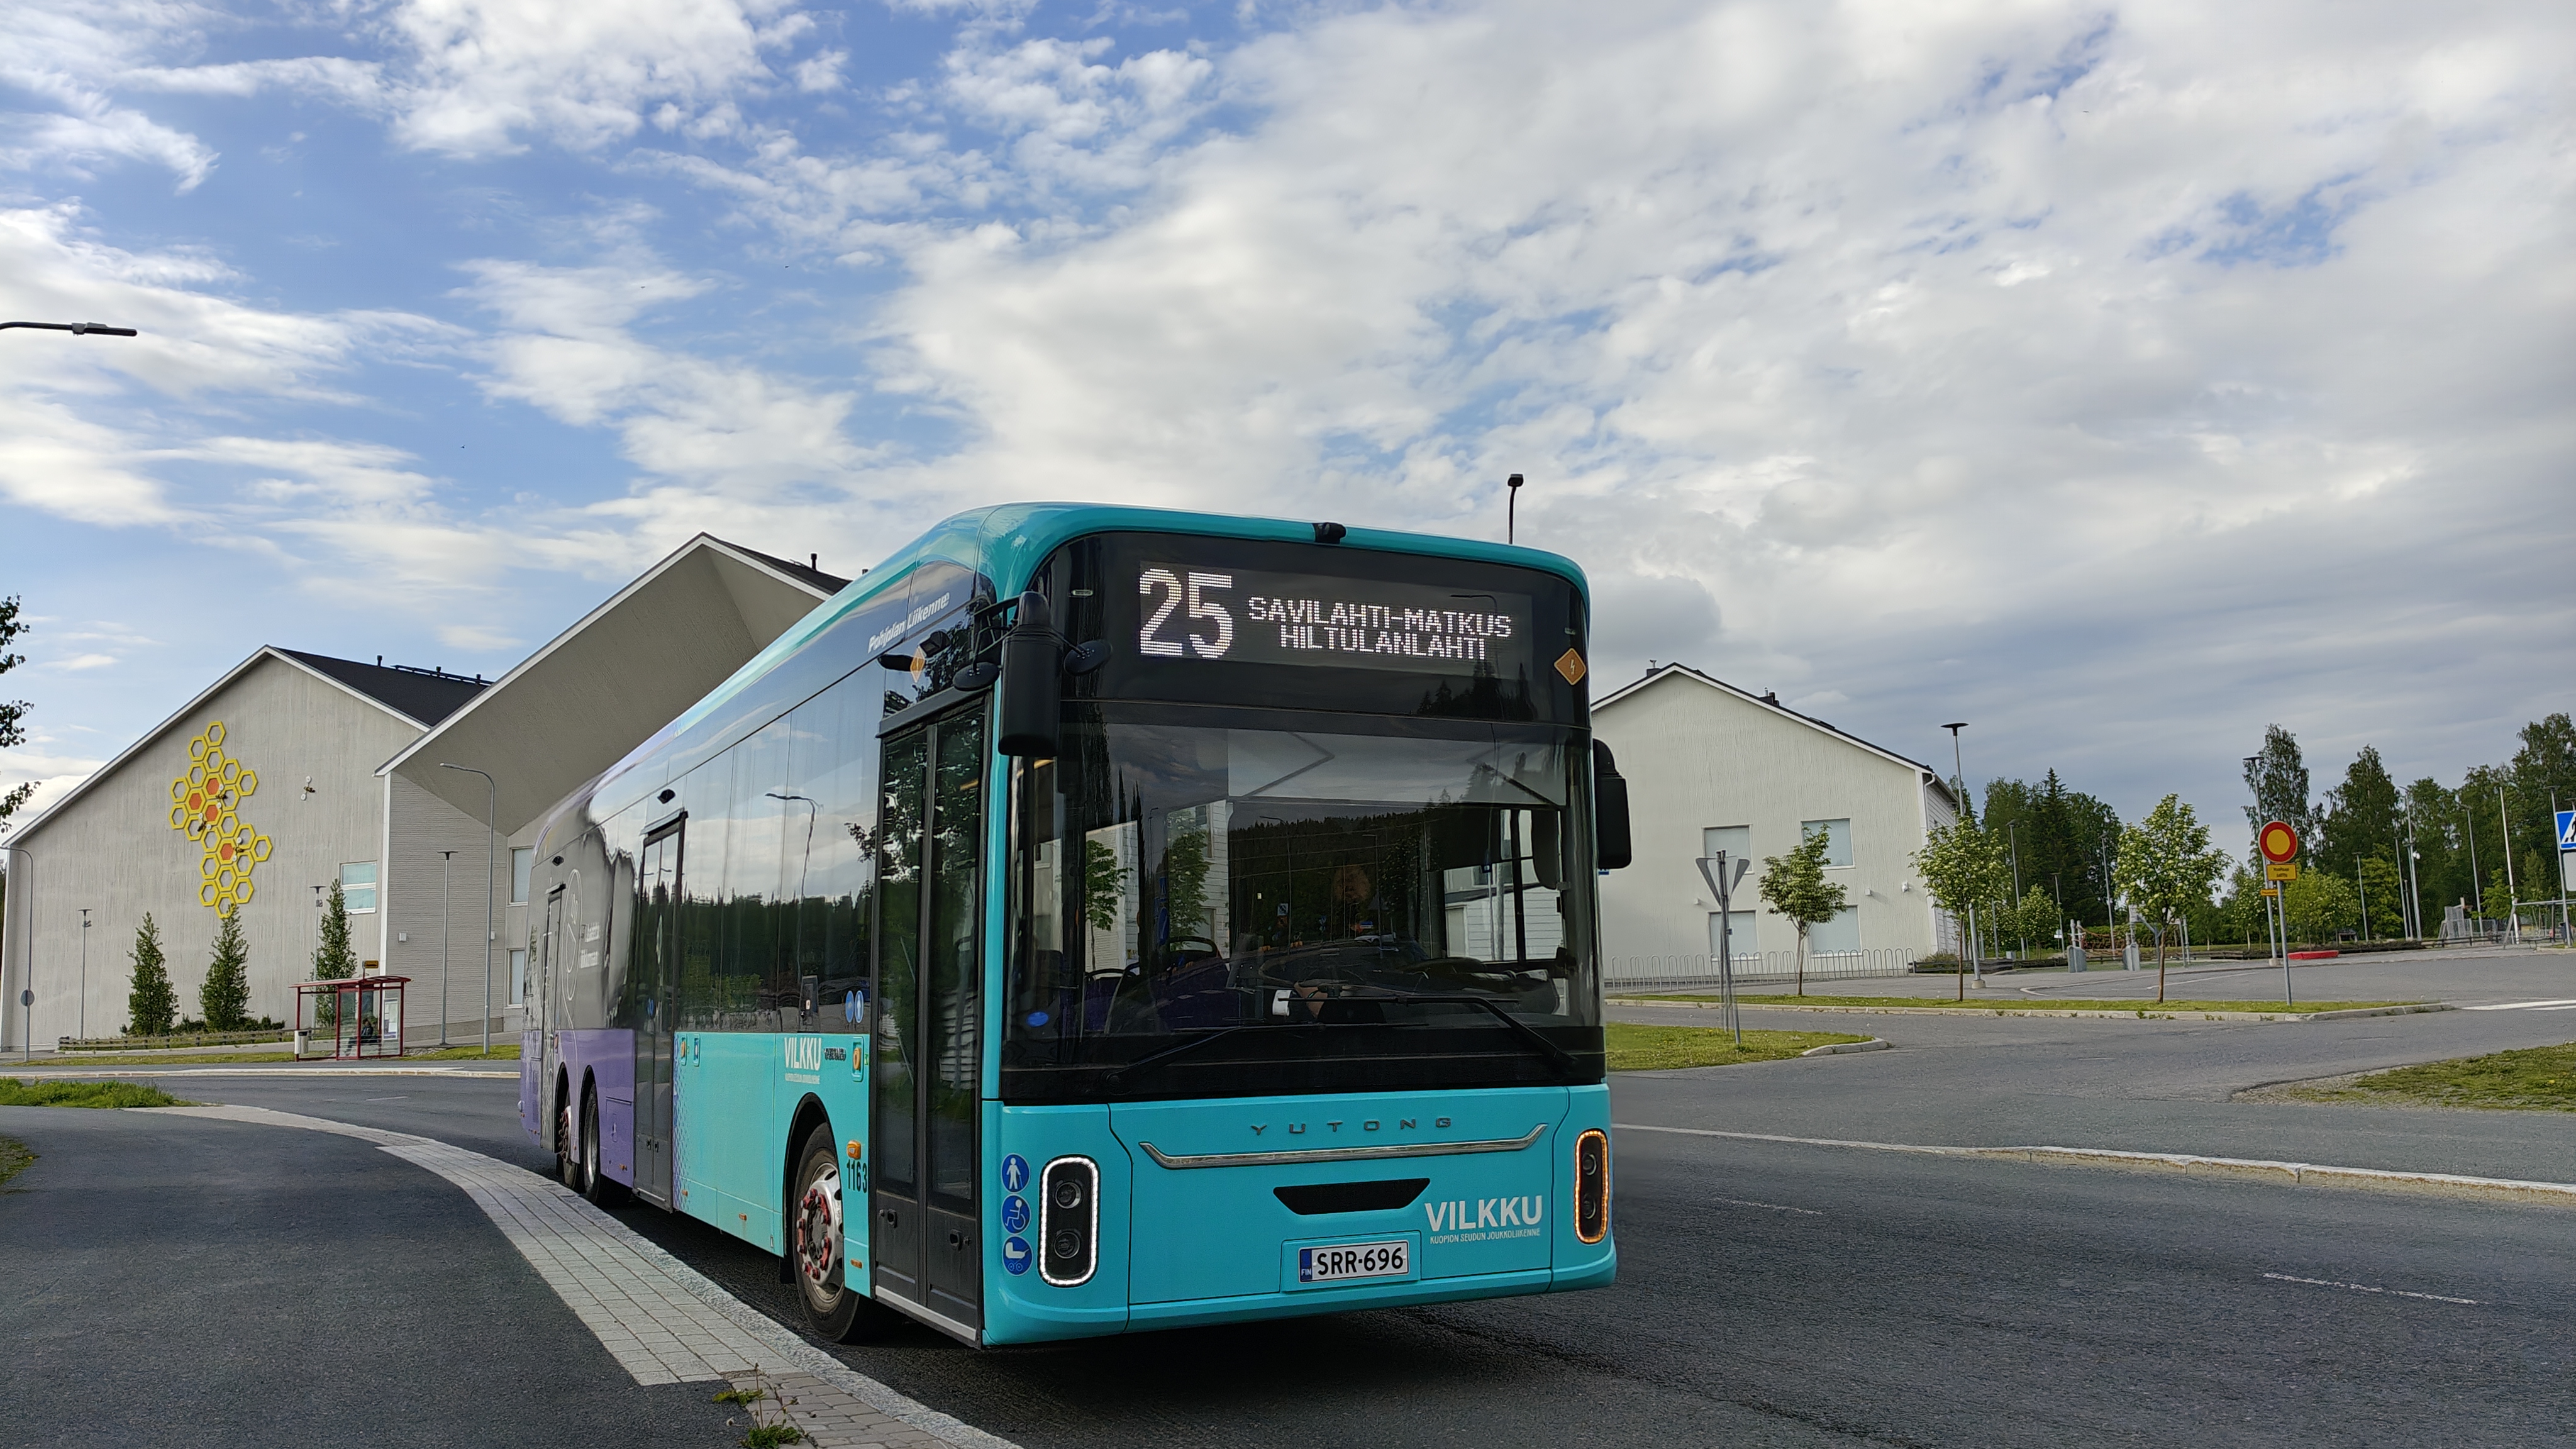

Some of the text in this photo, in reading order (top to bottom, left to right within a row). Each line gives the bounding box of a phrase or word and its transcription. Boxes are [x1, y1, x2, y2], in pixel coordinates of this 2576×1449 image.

[907, 592, 951, 630] Liikenne
[1139, 568, 1233, 659] 25
[1248, 596, 1512, 638] SAVILAHTI-MATKUS
[1280, 625, 1486, 661] HILTULANLAHTI
[784, 1037, 822, 1071] VILKKU
[1250, 1116, 1452, 1135] YUTONG
[846, 1159, 868, 1194] 1163
[1424, 1195, 1543, 1232] VILKKU
[1430, 1228, 1541, 1245] KUOPION SEUDUN JOUKKOLIIKENNE
[1301, 1268, 1312, 1276] FIN
[1317, 1246, 1404, 1275] SRR-696
